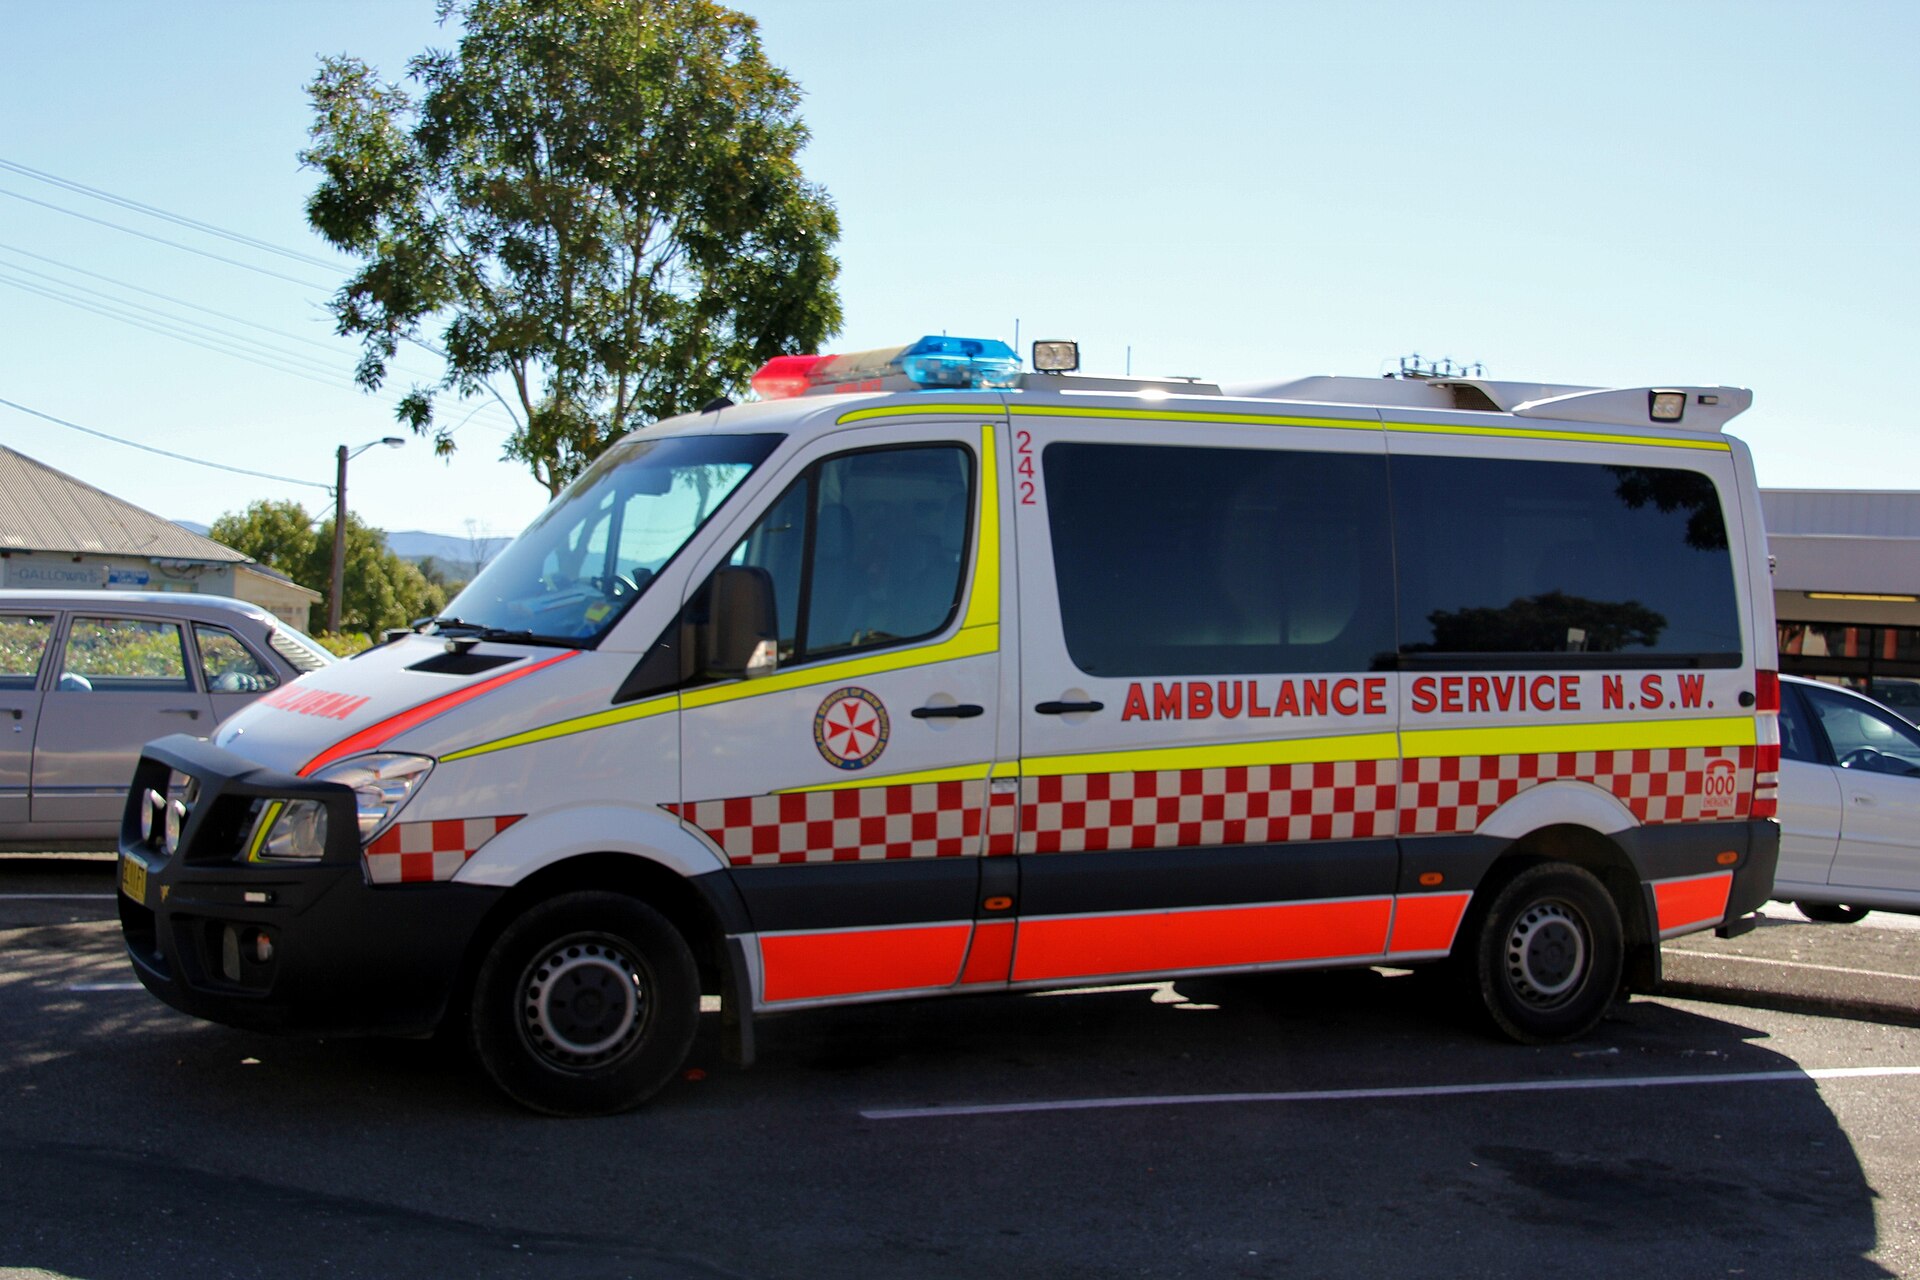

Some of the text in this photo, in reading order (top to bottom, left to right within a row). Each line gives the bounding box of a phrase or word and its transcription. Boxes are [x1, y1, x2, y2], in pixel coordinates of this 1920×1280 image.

[1016, 430, 1036, 505] 242
[1121, 674, 1714, 721] AMBULANCE SERVICE N.S.W.
[1705, 775, 1735, 796] 000
